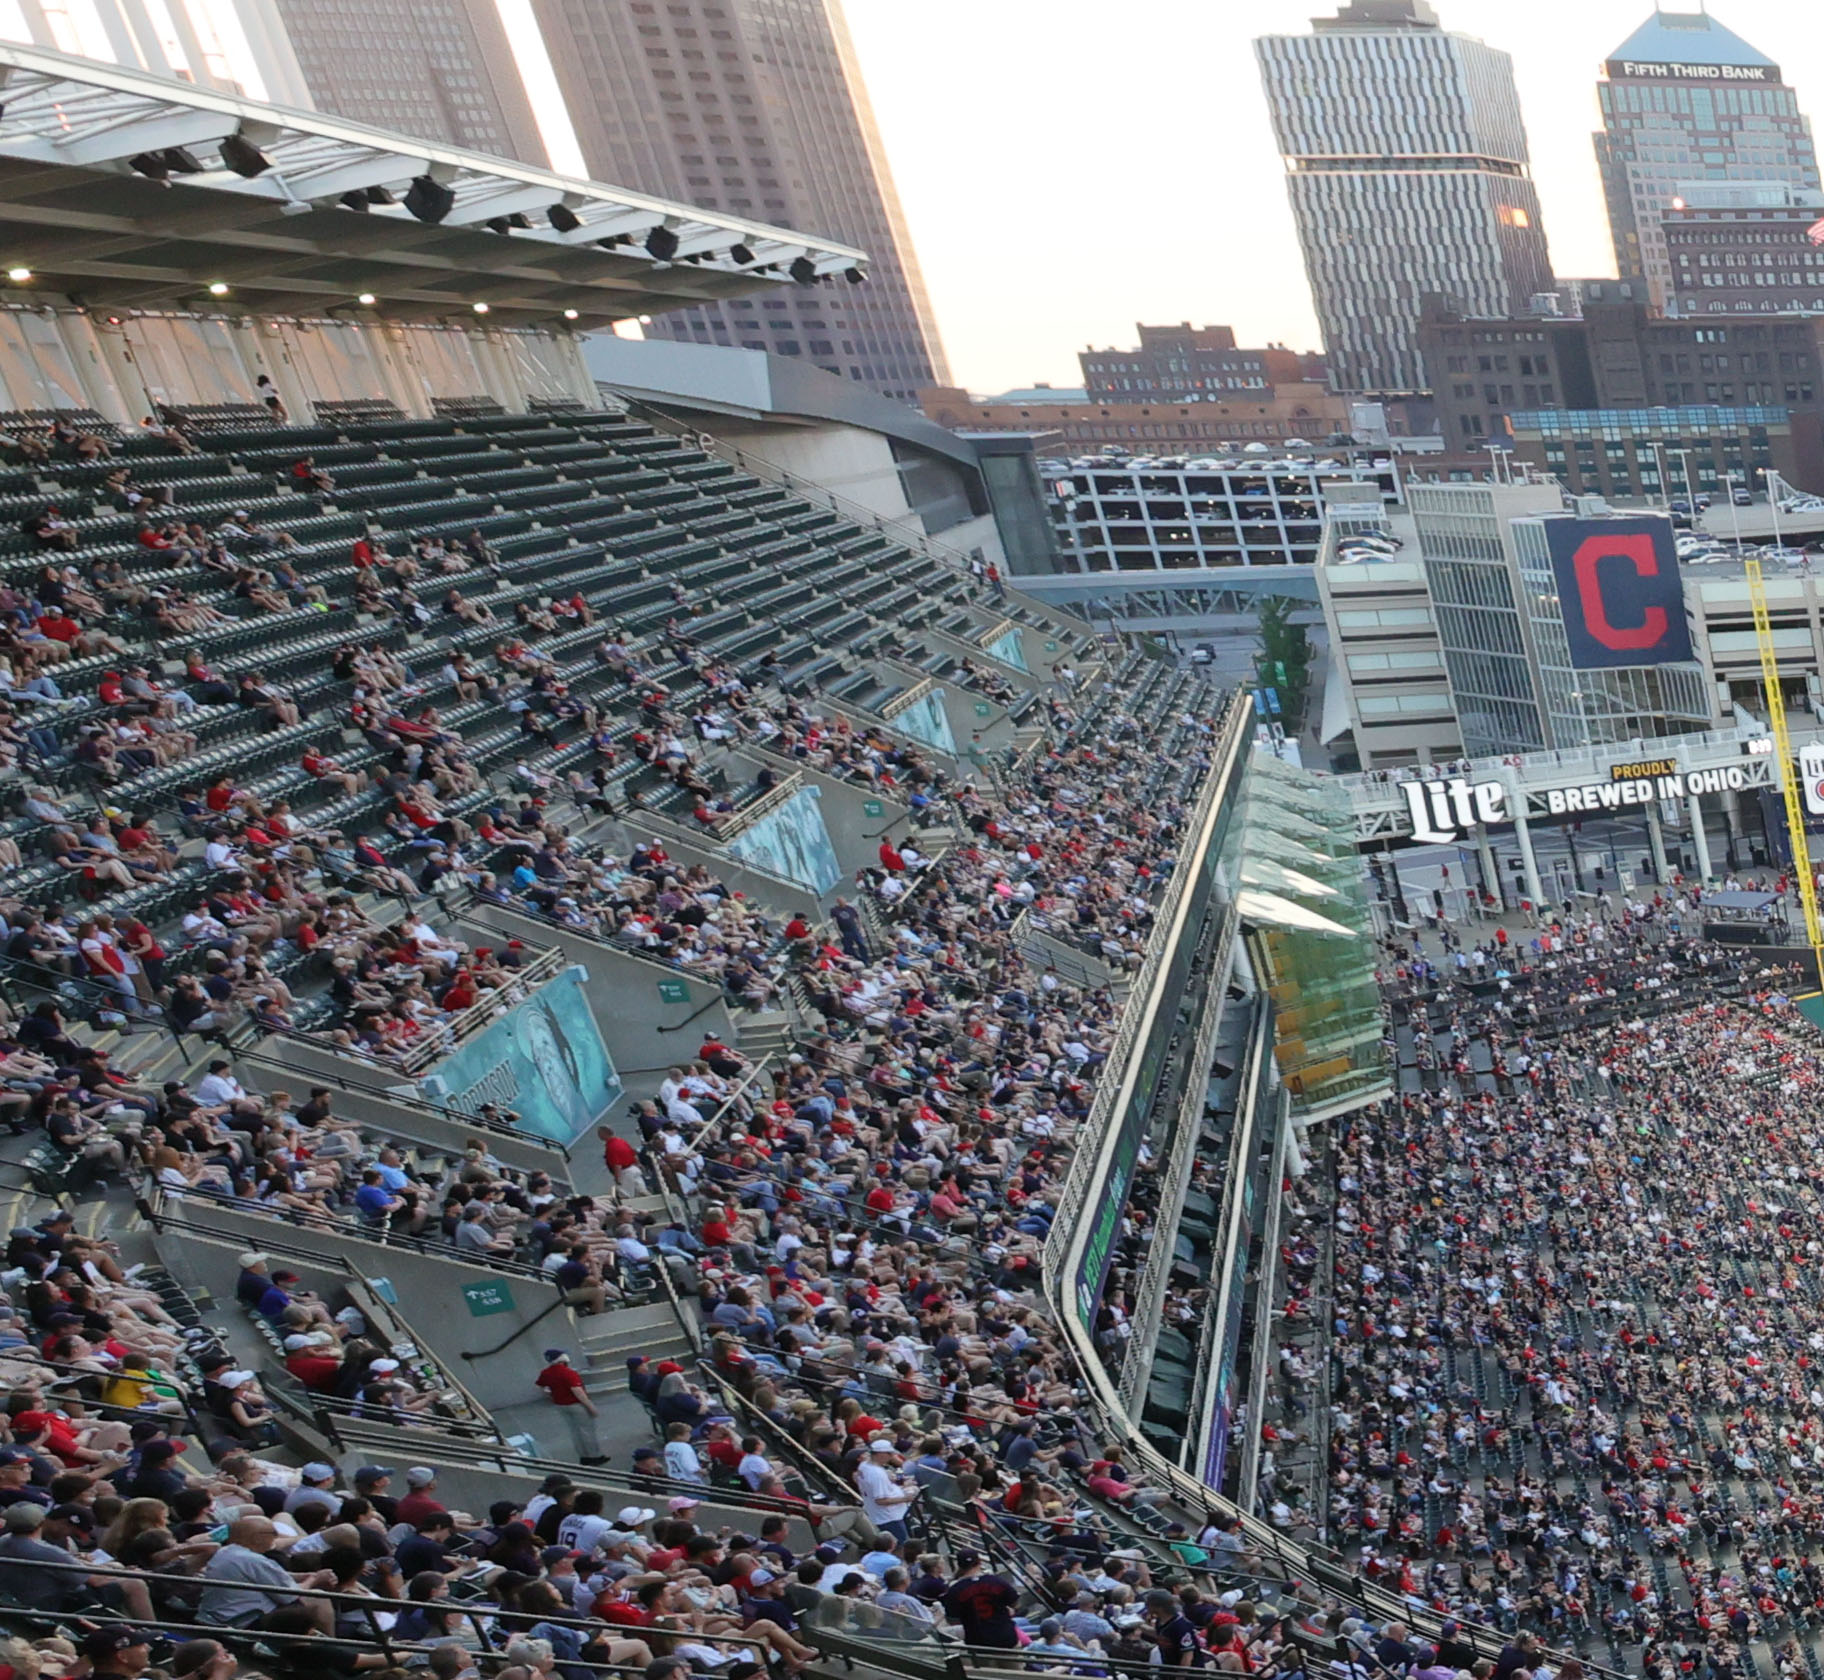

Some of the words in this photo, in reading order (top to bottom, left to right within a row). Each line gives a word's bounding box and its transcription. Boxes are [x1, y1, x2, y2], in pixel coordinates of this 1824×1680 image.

[1623, 61, 1668, 77] FIFTH
[1670, 63, 1723, 79] THIRD
[1725, 64, 1765, 80] BANK
[1572, 533, 1668, 650] C
[1547, 778, 1654, 815] BREWED
[1658, 774, 1685, 800] IN
[1687, 767, 1743, 796] OHIO
[1612, 758, 1677, 780] PROUDLY
[1399, 778, 1506, 844] Lite
